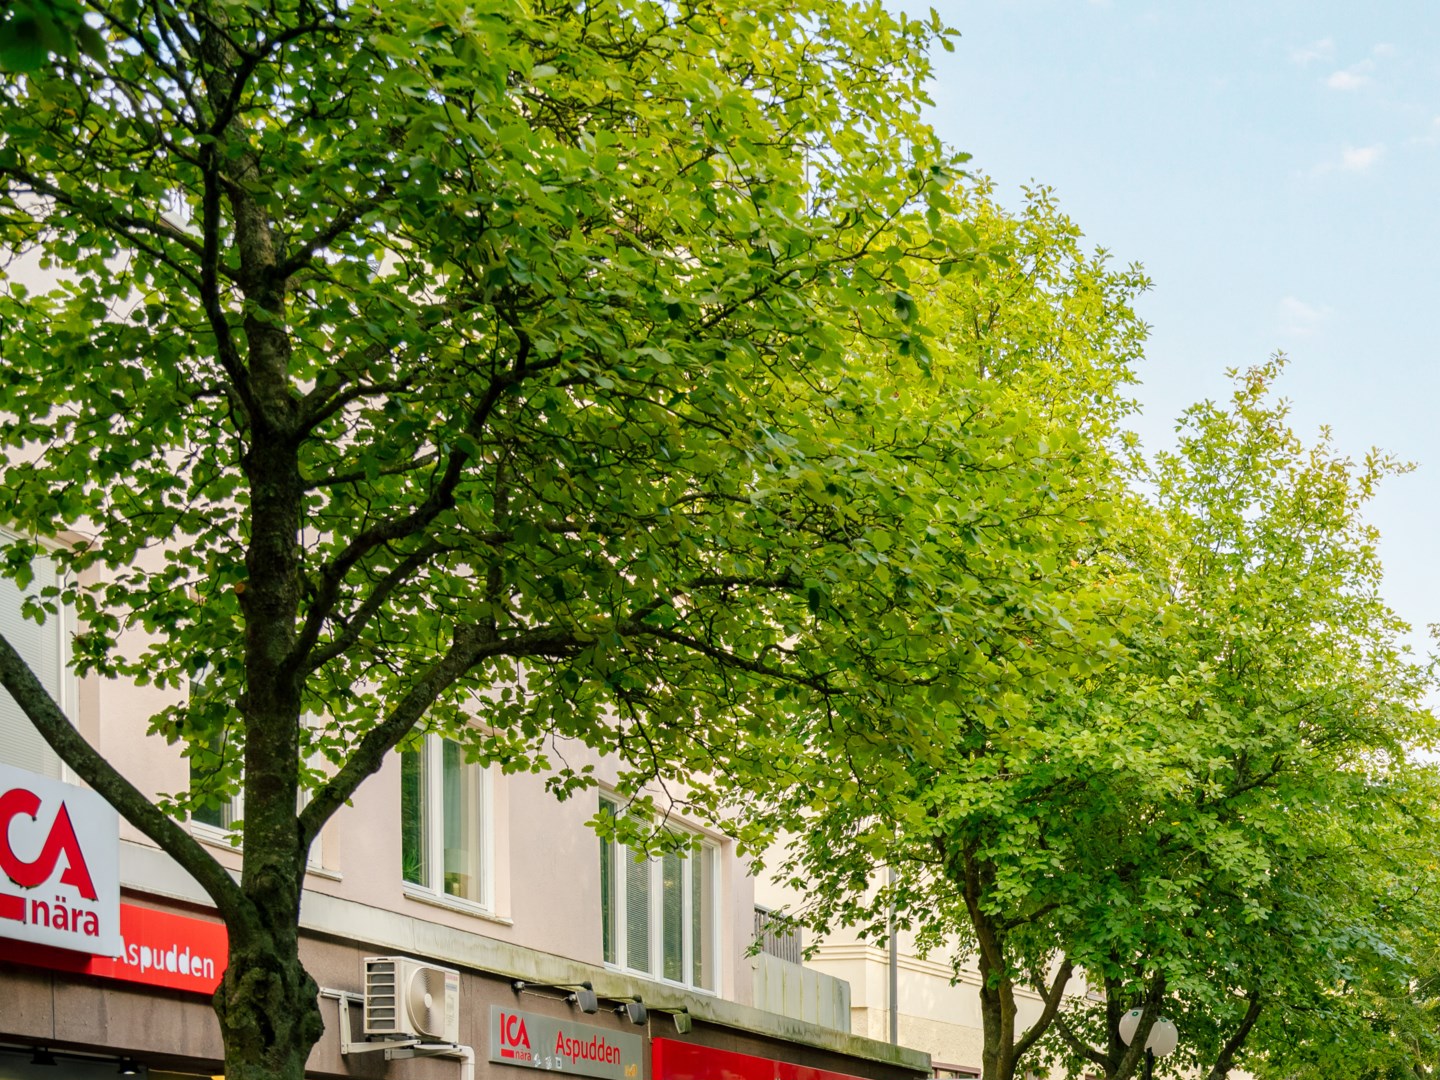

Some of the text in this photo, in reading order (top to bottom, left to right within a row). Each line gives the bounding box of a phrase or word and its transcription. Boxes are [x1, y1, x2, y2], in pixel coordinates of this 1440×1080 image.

[31, 895, 100, 937] nära
[112, 935, 215, 979] Aspudden
[499, 1012, 531, 1050] ICA
[555, 1030, 621, 1065] Aspudden
[515, 1048, 532, 1062] nära
